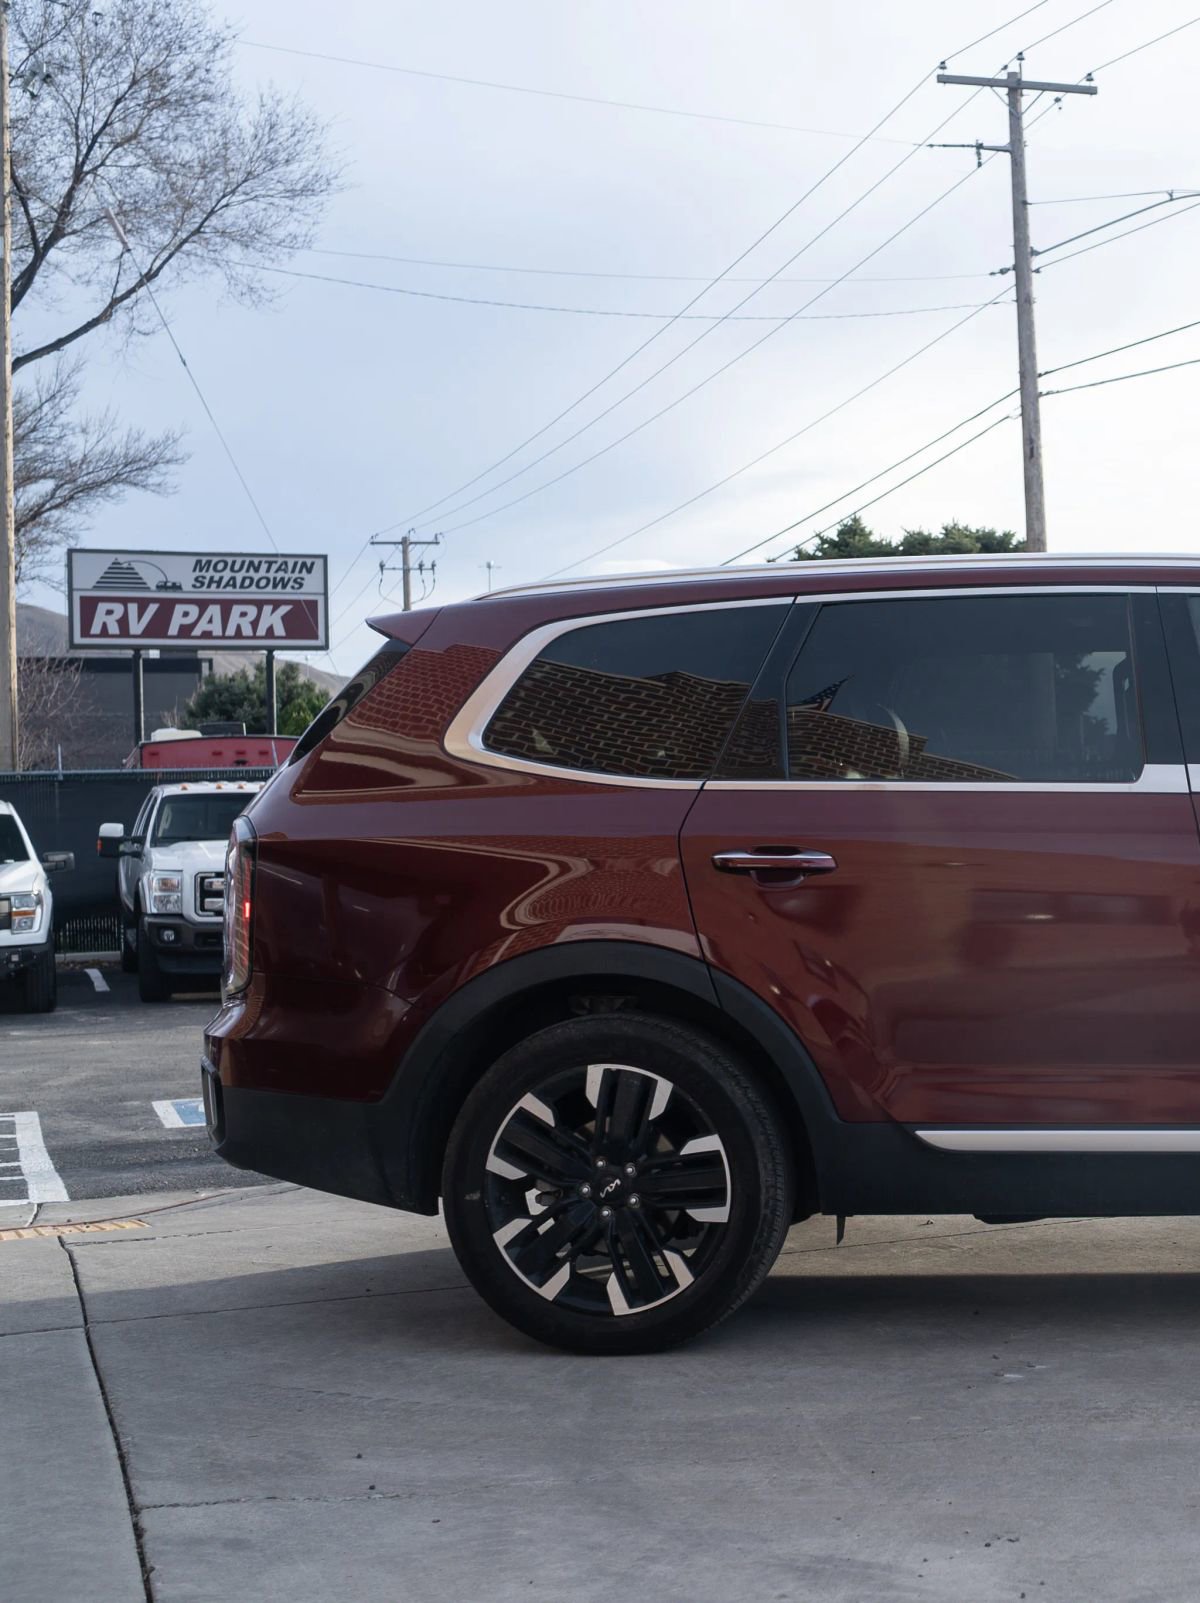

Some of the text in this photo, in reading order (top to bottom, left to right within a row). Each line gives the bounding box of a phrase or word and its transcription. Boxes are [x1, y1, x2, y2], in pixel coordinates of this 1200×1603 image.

[192, 559, 315, 575] MOUNTAIN
[191, 575, 305, 590] SHADOWS
[89, 602, 294, 637] RV PARK
